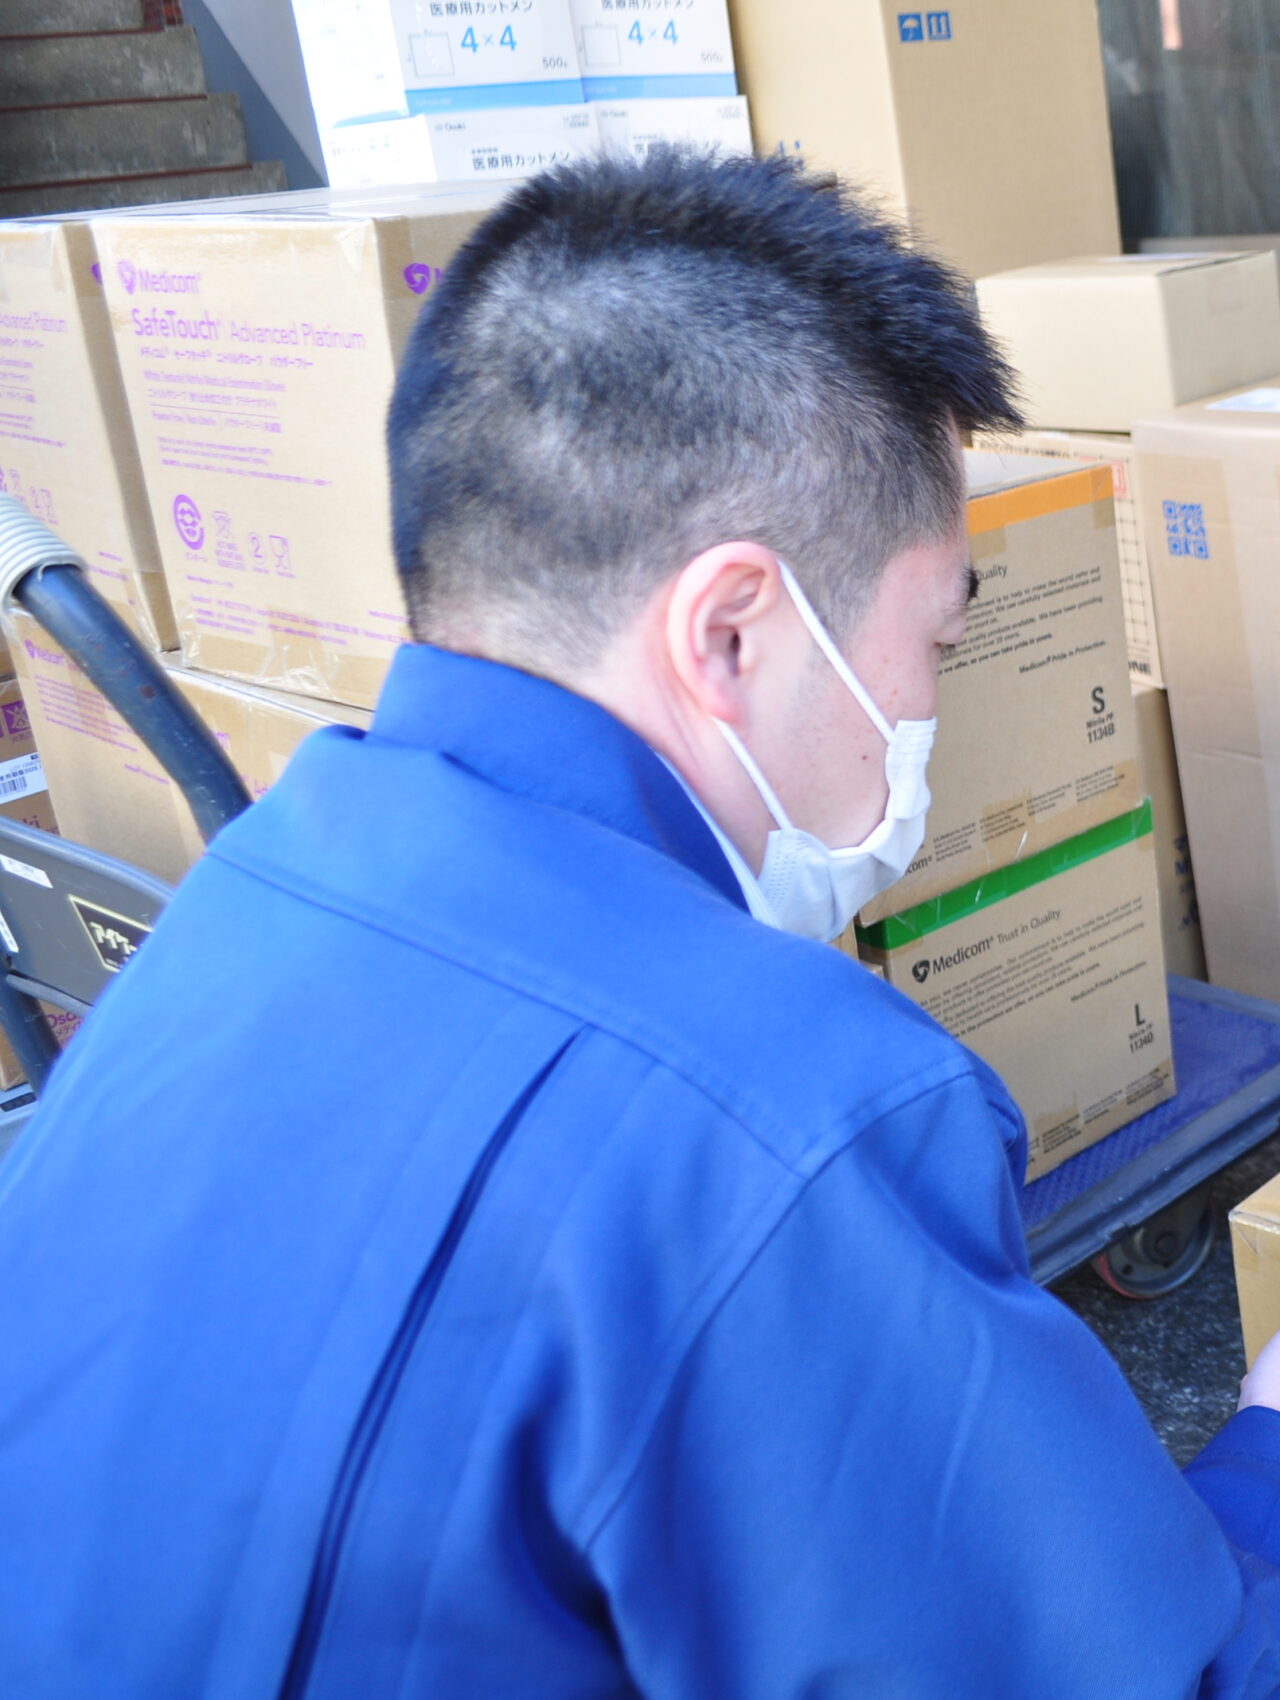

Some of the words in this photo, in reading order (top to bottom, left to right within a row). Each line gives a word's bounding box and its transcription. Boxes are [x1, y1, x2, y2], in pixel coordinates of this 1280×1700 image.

[430, 1, 533, 16] 医療用カットメン
[472, 150, 571, 171] 医療用カットメン
[300, 322, 367, 350] Platinum
[1090, 685, 1106, 715] S
[996, 927, 1019, 945] Trust
[1019, 923, 1029, 935] in
[1030, 909, 1062, 931] Quality
[1134, 1003, 1146, 1027] L
